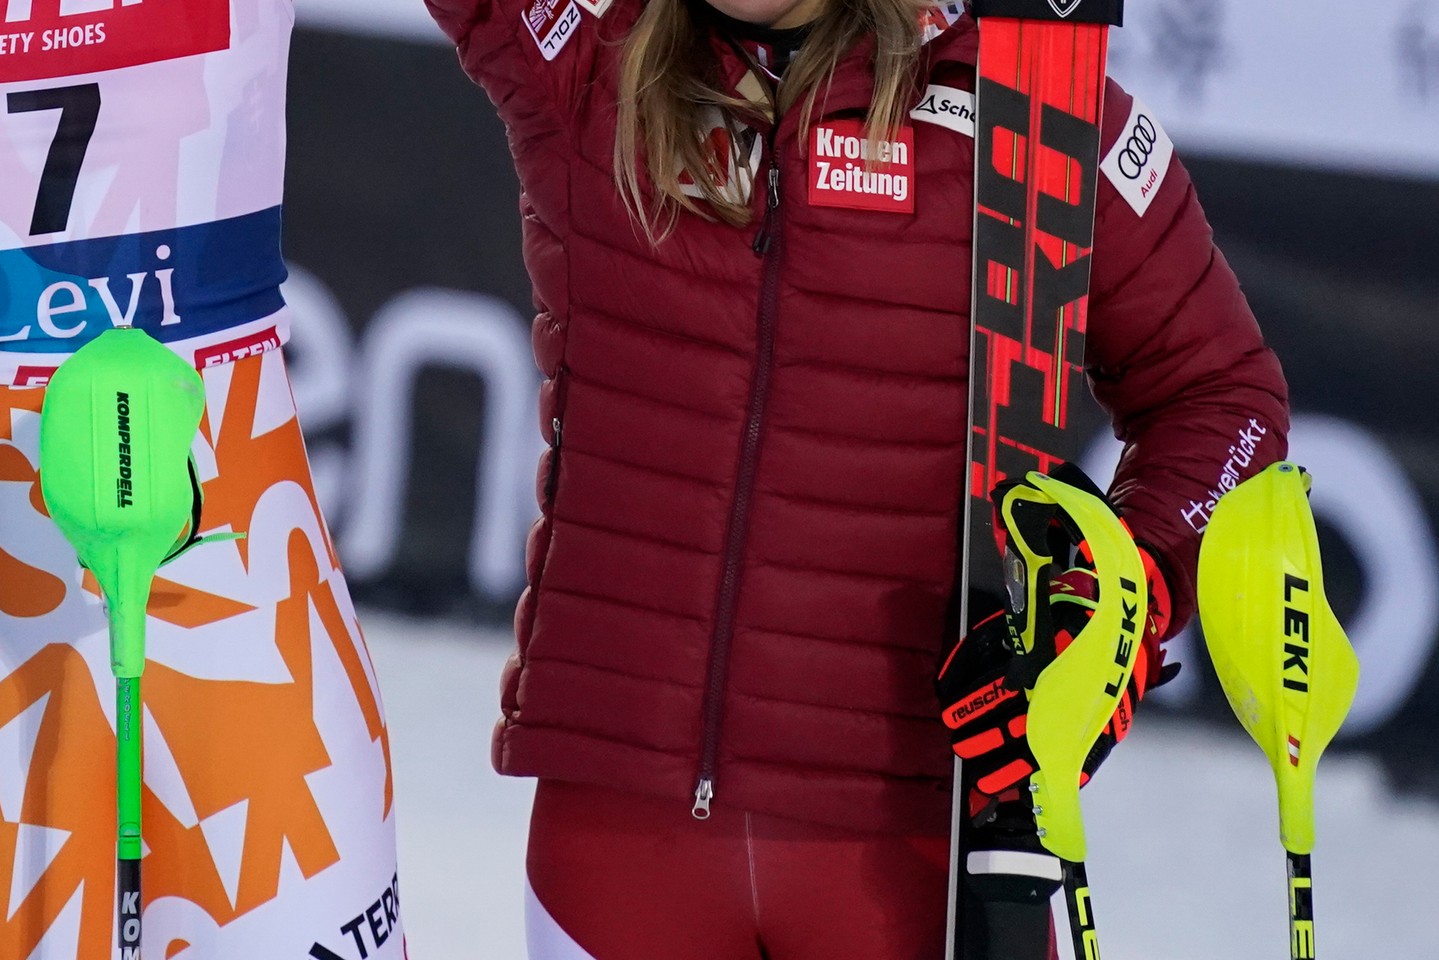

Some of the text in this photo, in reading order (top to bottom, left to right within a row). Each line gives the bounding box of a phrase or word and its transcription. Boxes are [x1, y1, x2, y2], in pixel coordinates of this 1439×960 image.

[41, 21, 106, 52] SHOES
[543, 6, 579, 51] ZOLL
[5, 82, 102, 237] 7
[816, 127, 908, 165] Kroen
[816, 161, 908, 202] Zeitung
[1140, 169, 1159, 200] Audi
[116, 390, 134, 509] KOMPERDELL
[1005, 612, 1025, 656] LEKI
[1103, 575, 1138, 700] LEKI
[1282, 570, 1310, 694] LEKI
[951, 682, 1007, 724] reusch
[1075, 886, 1102, 960] LE
[1290, 877, 1316, 960] LE
